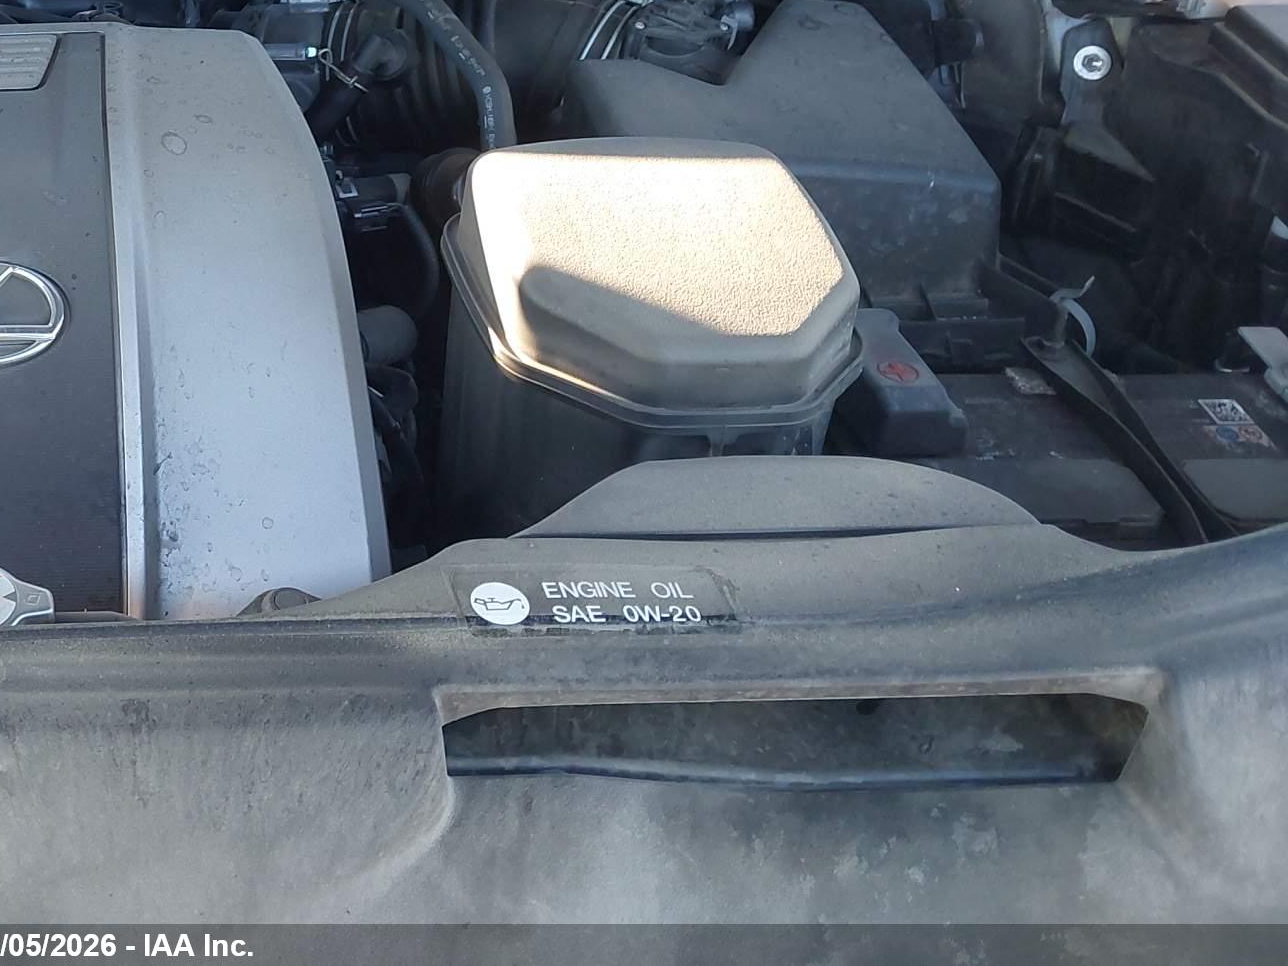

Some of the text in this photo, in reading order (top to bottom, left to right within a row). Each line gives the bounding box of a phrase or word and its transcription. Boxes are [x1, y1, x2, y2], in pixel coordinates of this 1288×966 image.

[541, 581, 694, 599] ENGINE OIL
[552, 605, 702, 623] SAE 0W-20
